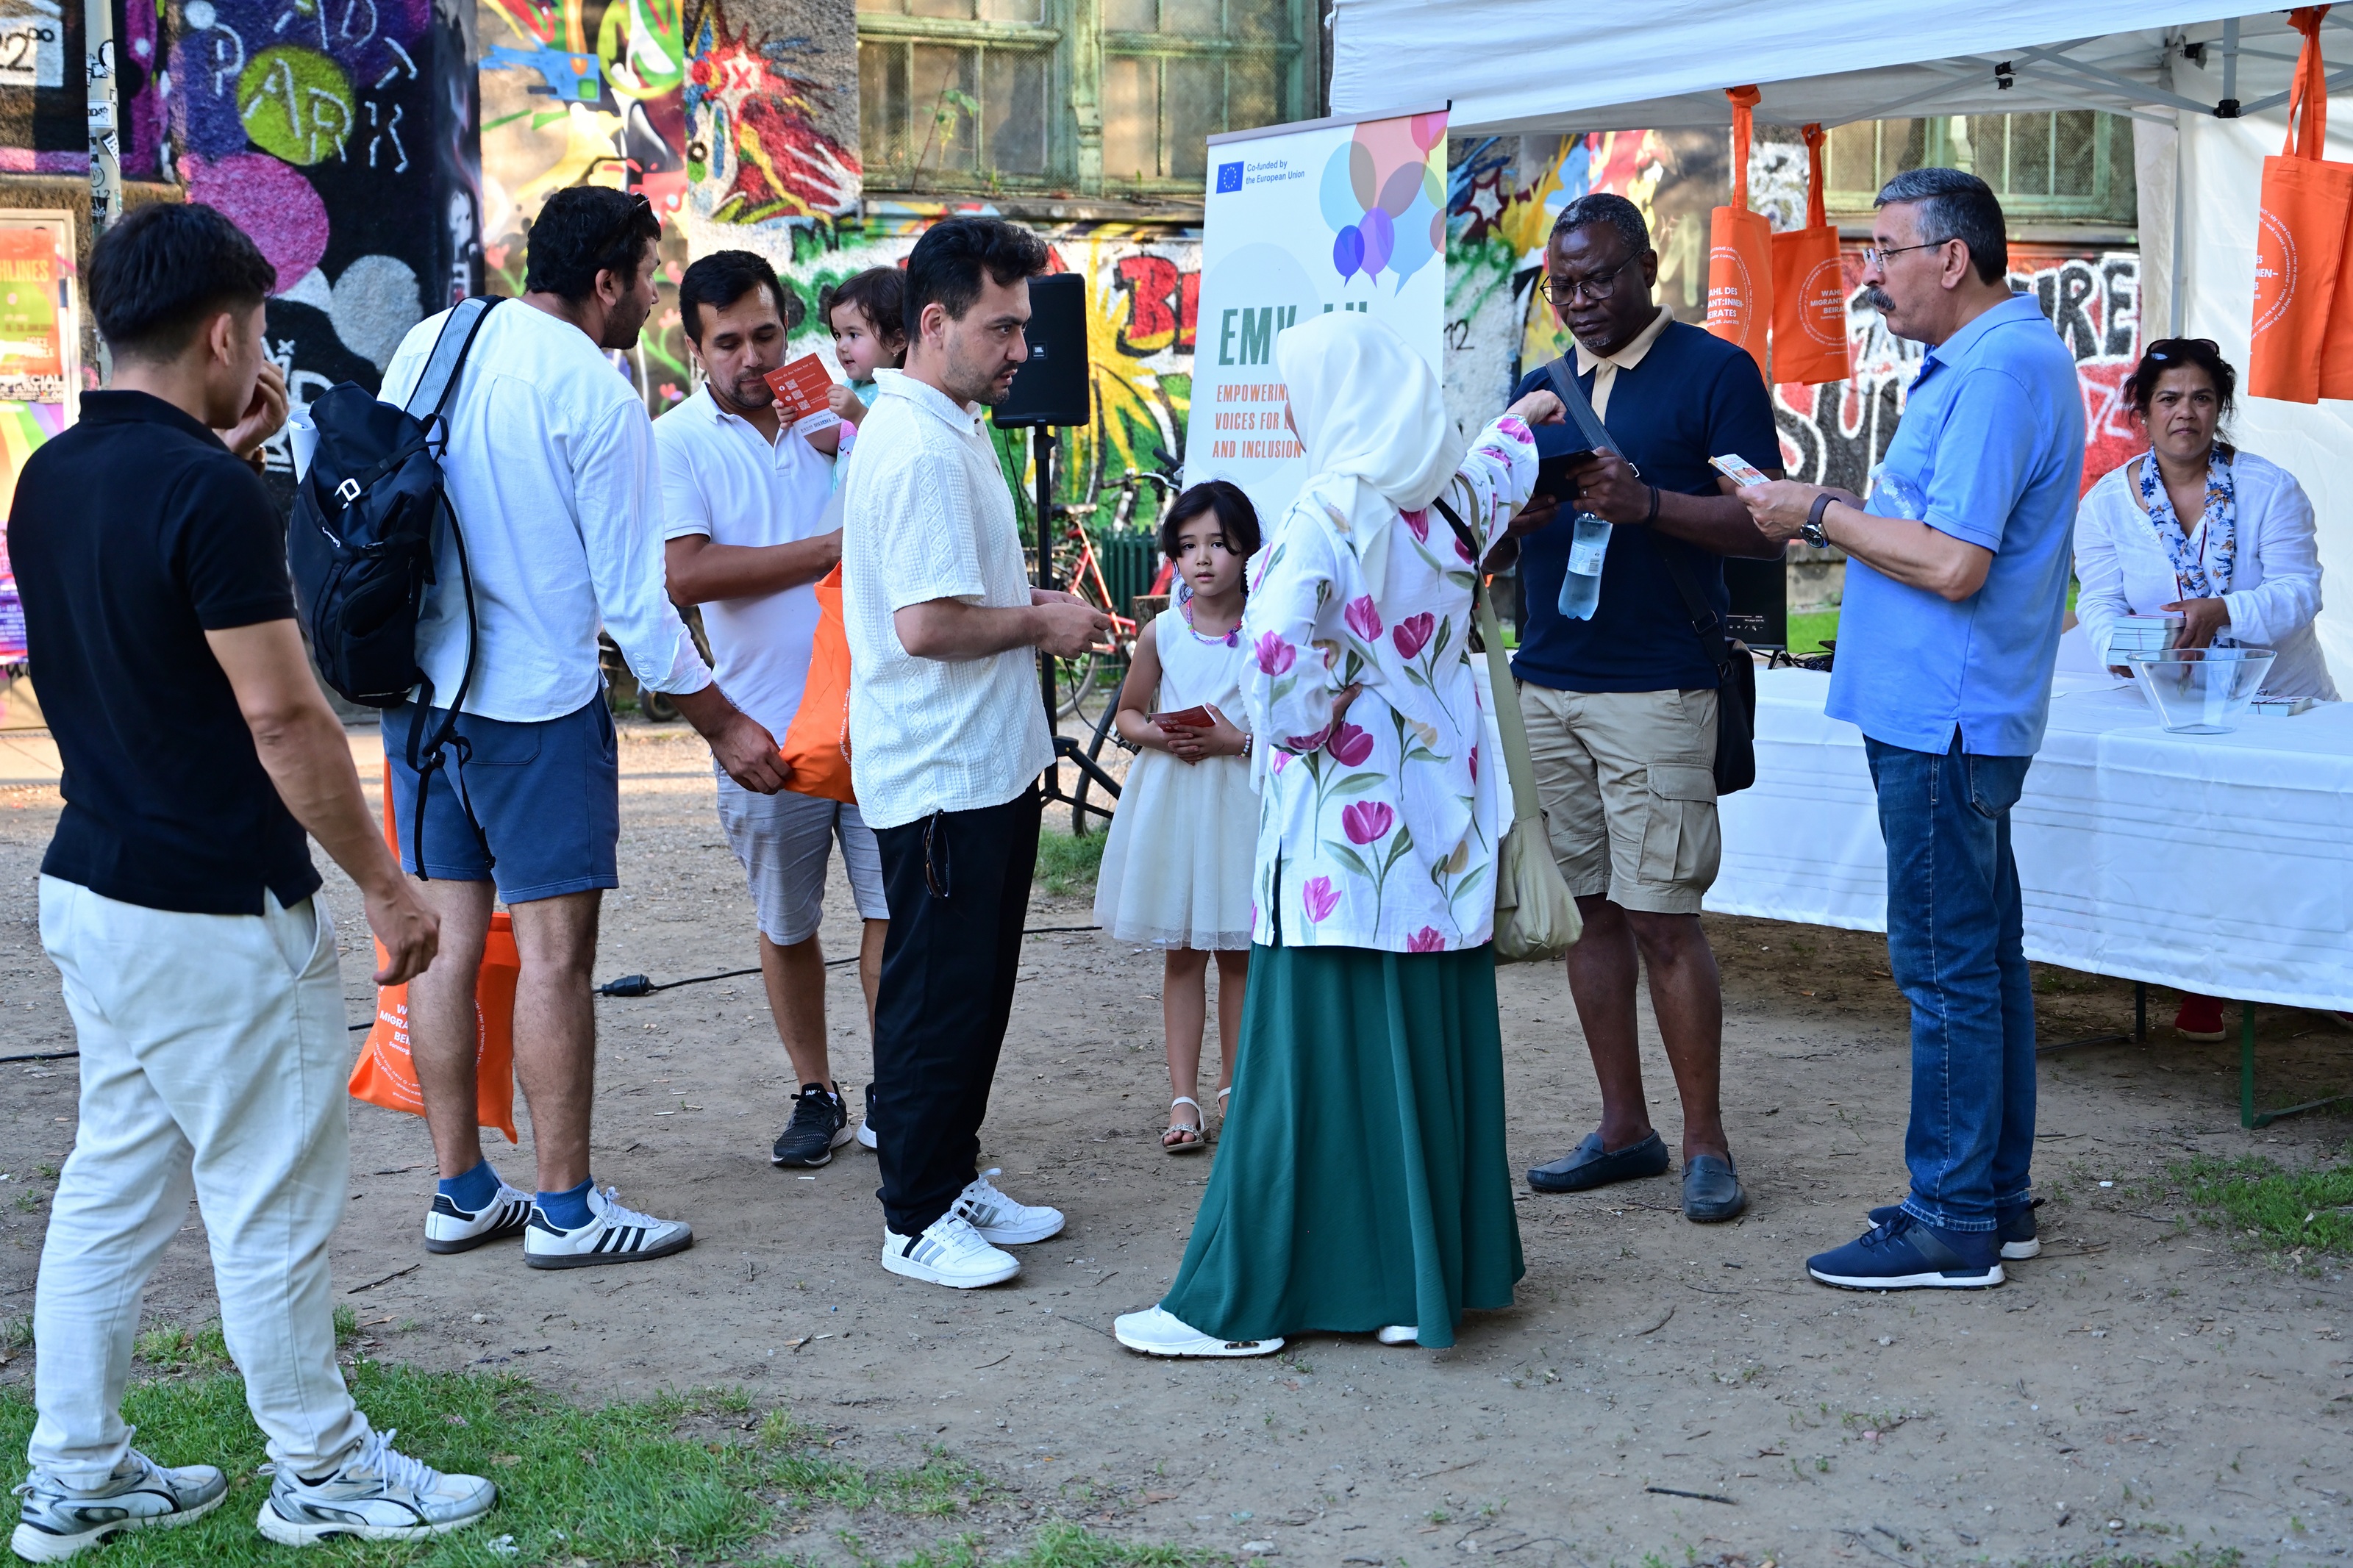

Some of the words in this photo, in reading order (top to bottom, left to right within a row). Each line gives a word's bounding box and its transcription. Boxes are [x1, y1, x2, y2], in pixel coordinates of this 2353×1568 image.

[1247, 160, 1278, 172] Co-funded
[1279, 160, 1288, 170] by
[1246, 176, 1255, 185] the
[1256, 173, 1286, 183] European
[1288, 170, 1305, 179] Union
[1708, 287, 1723, 297] AHL
[1724, 287, 1738, 296] DES
[1217, 383, 1288, 402] EMPOWERIN
[1215, 412, 1255, 430] VOICES
[1260, 412, 1279, 430] FOR
[1212, 440, 1236, 458] AND
[1242, 440, 1302, 458] INCLUSION
